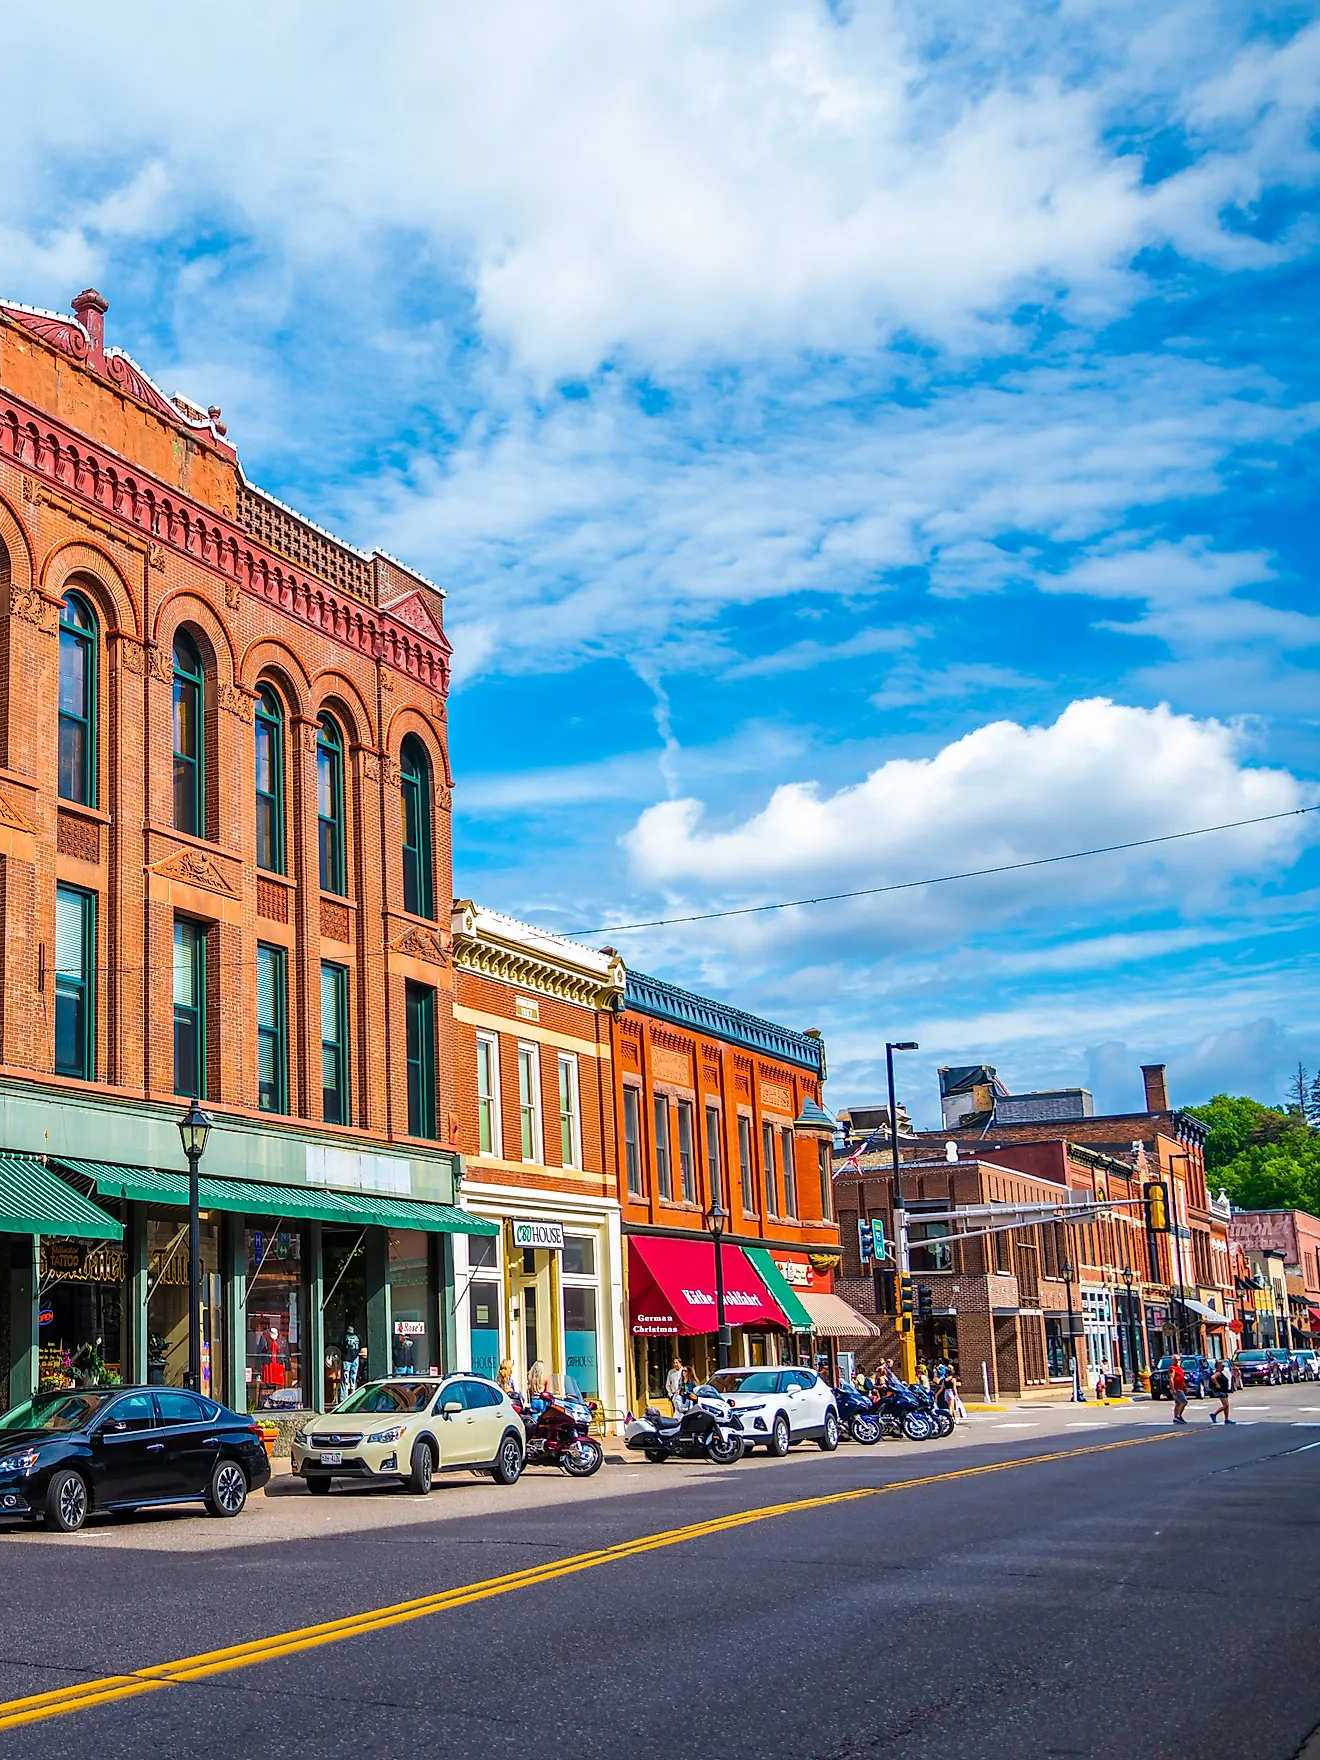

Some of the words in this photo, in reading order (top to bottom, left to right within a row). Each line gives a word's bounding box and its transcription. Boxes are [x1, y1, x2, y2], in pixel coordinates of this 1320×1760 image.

[1229, 1215, 1290, 1237] imonet
[532, 1226, 562, 1244] HOUSE
[50, 1254, 79, 1267] TATTOO
[714, 1290, 763, 1306] ohlfahrt
[637, 1314, 673, 1322] German
[633, 1325, 678, 1333] Christmas
